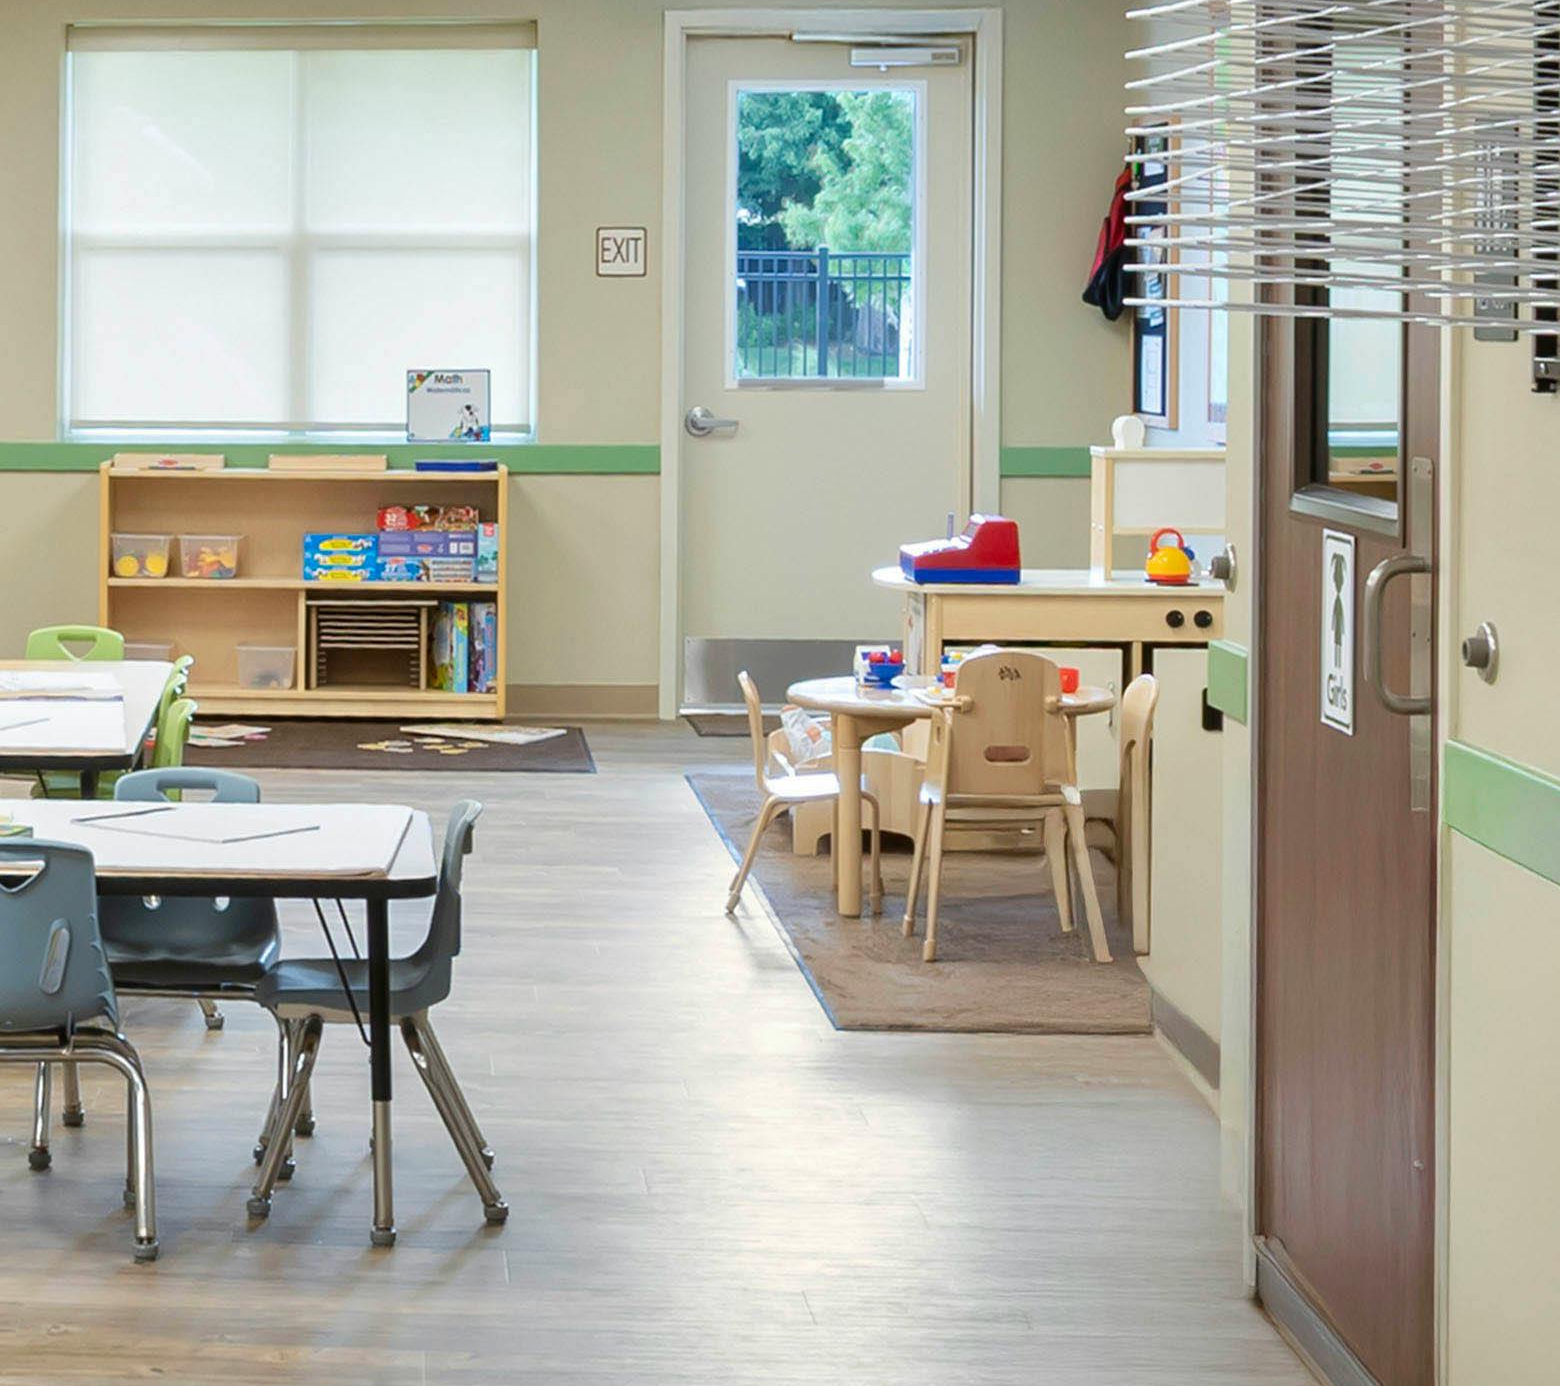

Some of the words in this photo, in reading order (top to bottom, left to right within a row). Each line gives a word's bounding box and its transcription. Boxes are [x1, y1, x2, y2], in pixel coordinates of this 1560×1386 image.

[601, 237, 642, 263] EXIT
[434, 374, 464, 384] Math
[1326, 673, 1349, 712] Girls
